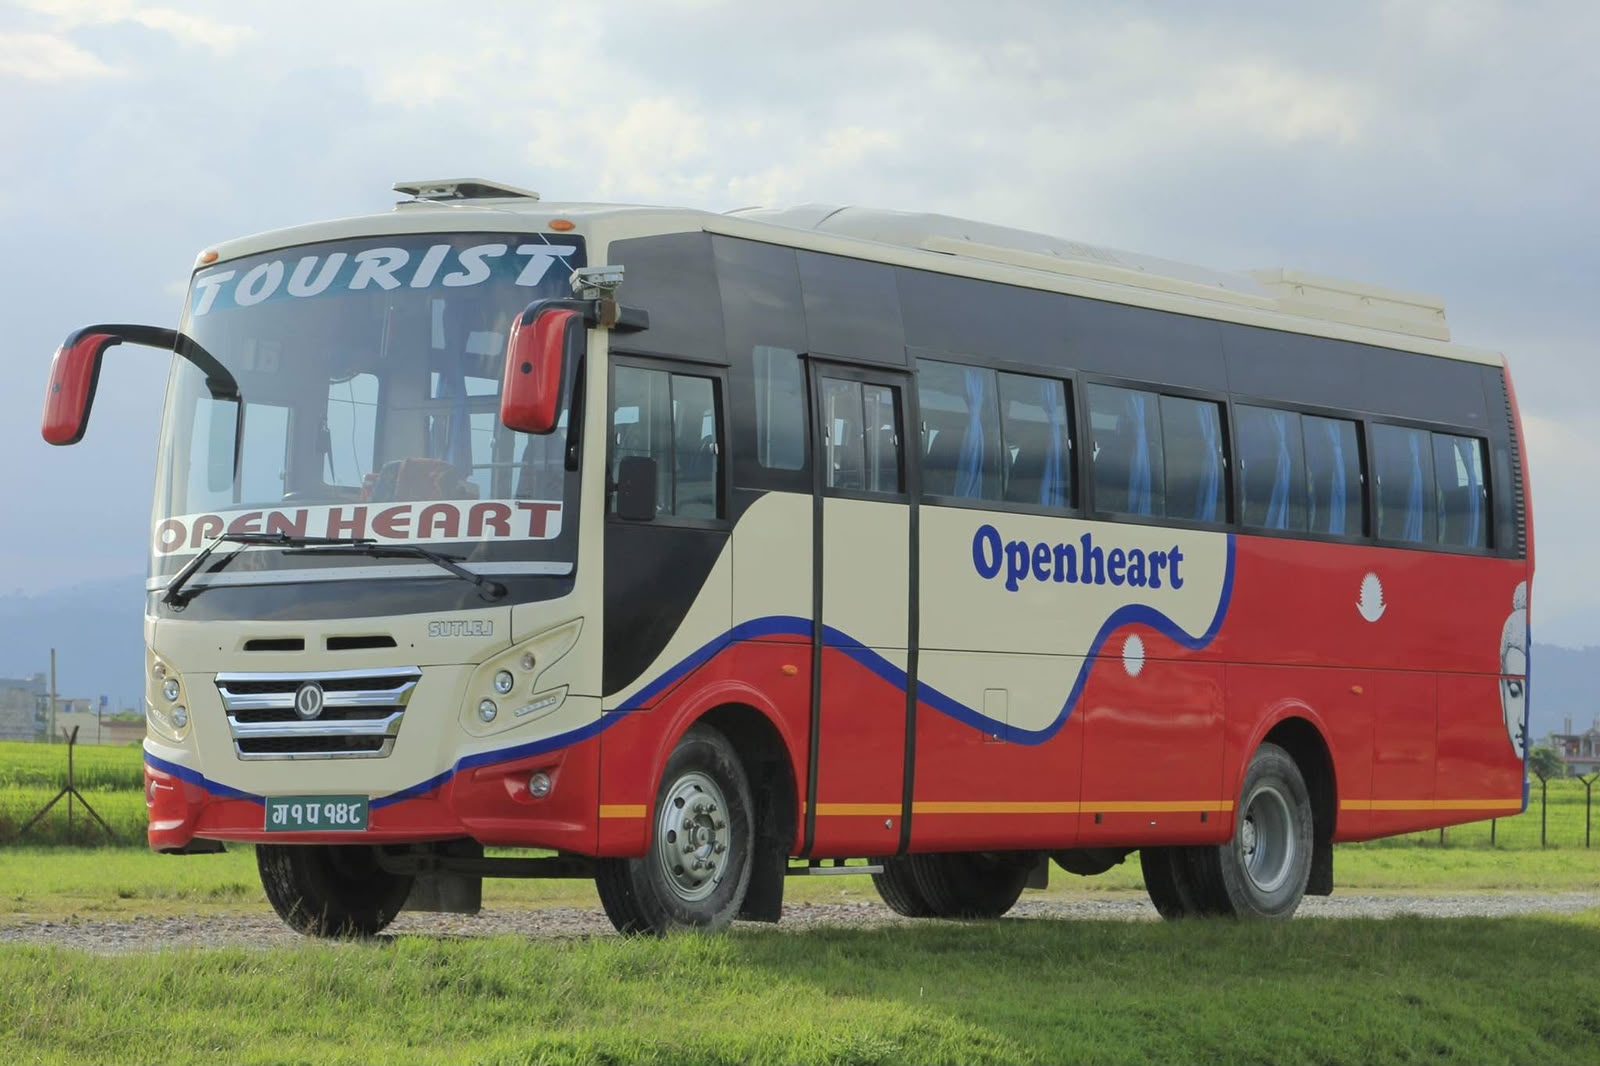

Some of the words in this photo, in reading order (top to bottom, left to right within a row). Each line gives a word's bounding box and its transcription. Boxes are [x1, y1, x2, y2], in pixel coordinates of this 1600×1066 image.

[195, 243, 577, 316] TOURIST
[154, 509, 309, 553] OPEN
[325, 502, 562, 541] HEART
[972, 524, 1184, 592] Openheart
[428, 620, 493, 637] SUTLEJ
